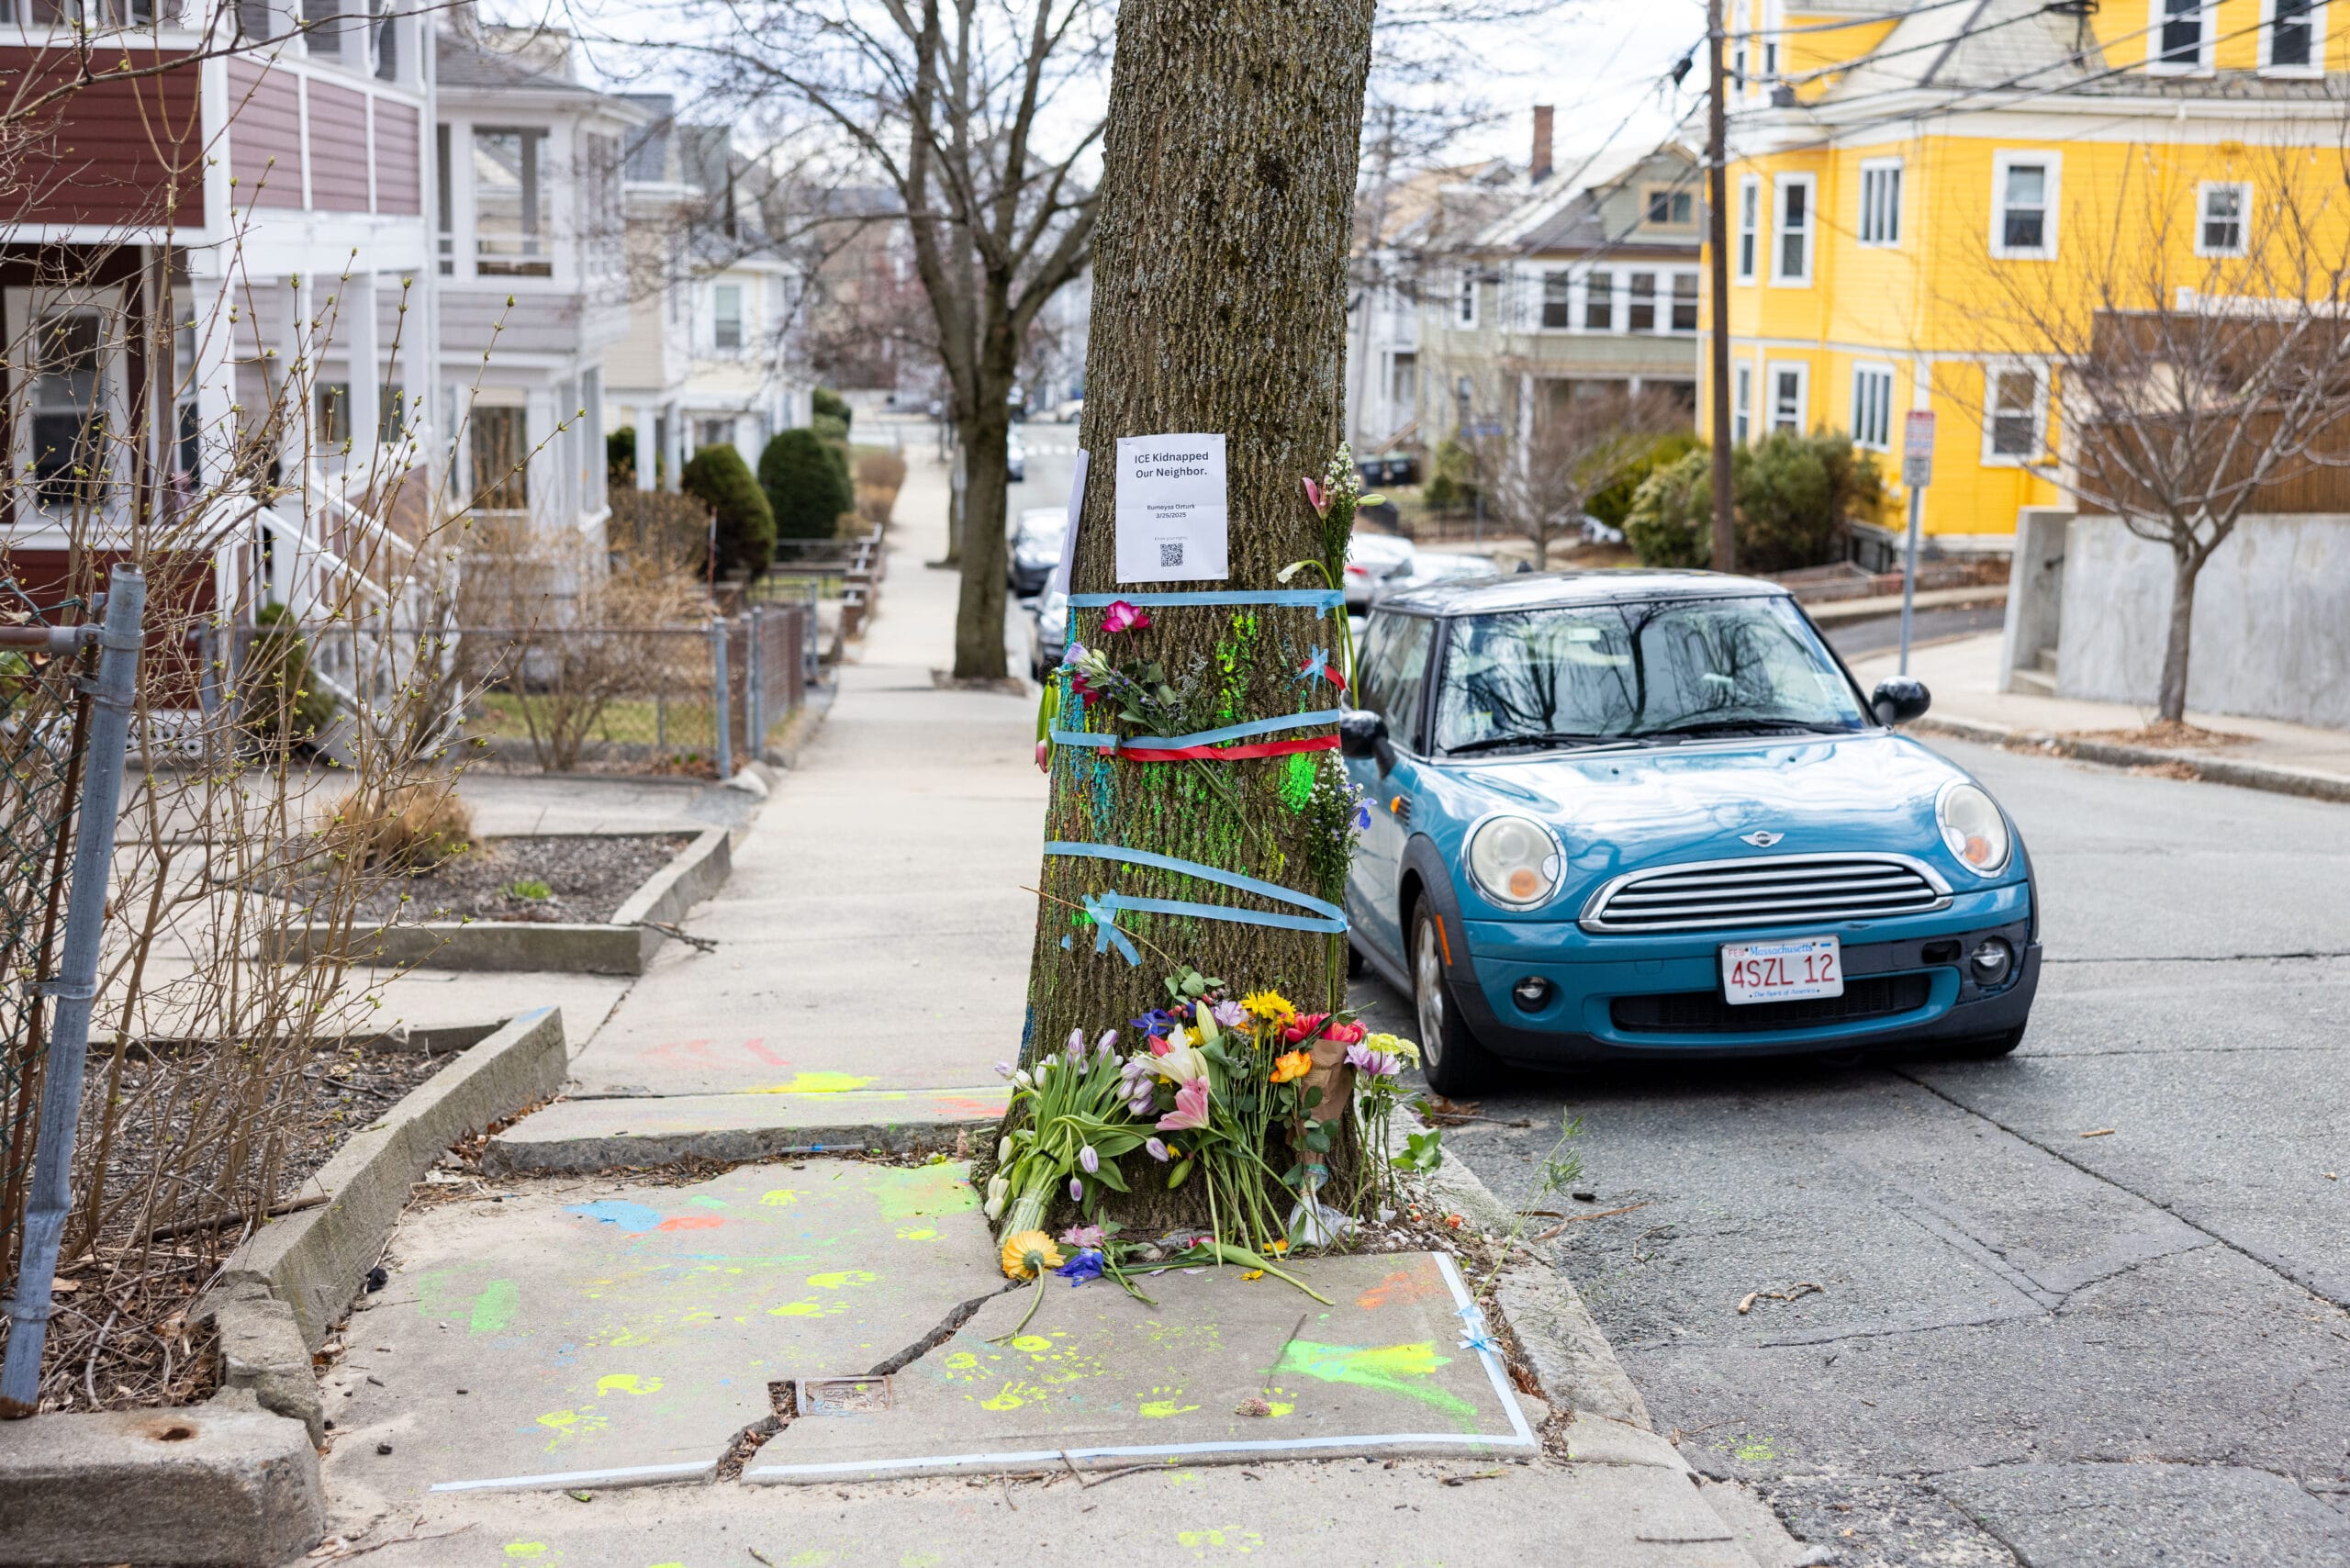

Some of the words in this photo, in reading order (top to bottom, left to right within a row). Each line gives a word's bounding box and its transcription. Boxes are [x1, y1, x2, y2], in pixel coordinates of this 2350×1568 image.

[1135, 454, 1150, 464] ICE
[1153, 452, 1209, 463] Kidnapped
[1136, 469, 1154, 478] Our
[1156, 467, 1207, 478] Neighbor.
[1728, 948, 1745, 957] FEB
[1750, 943, 1813, 956] Massachusetts
[1731, 957, 1794, 988] 4SZL
[1805, 953, 1835, 983] 12
